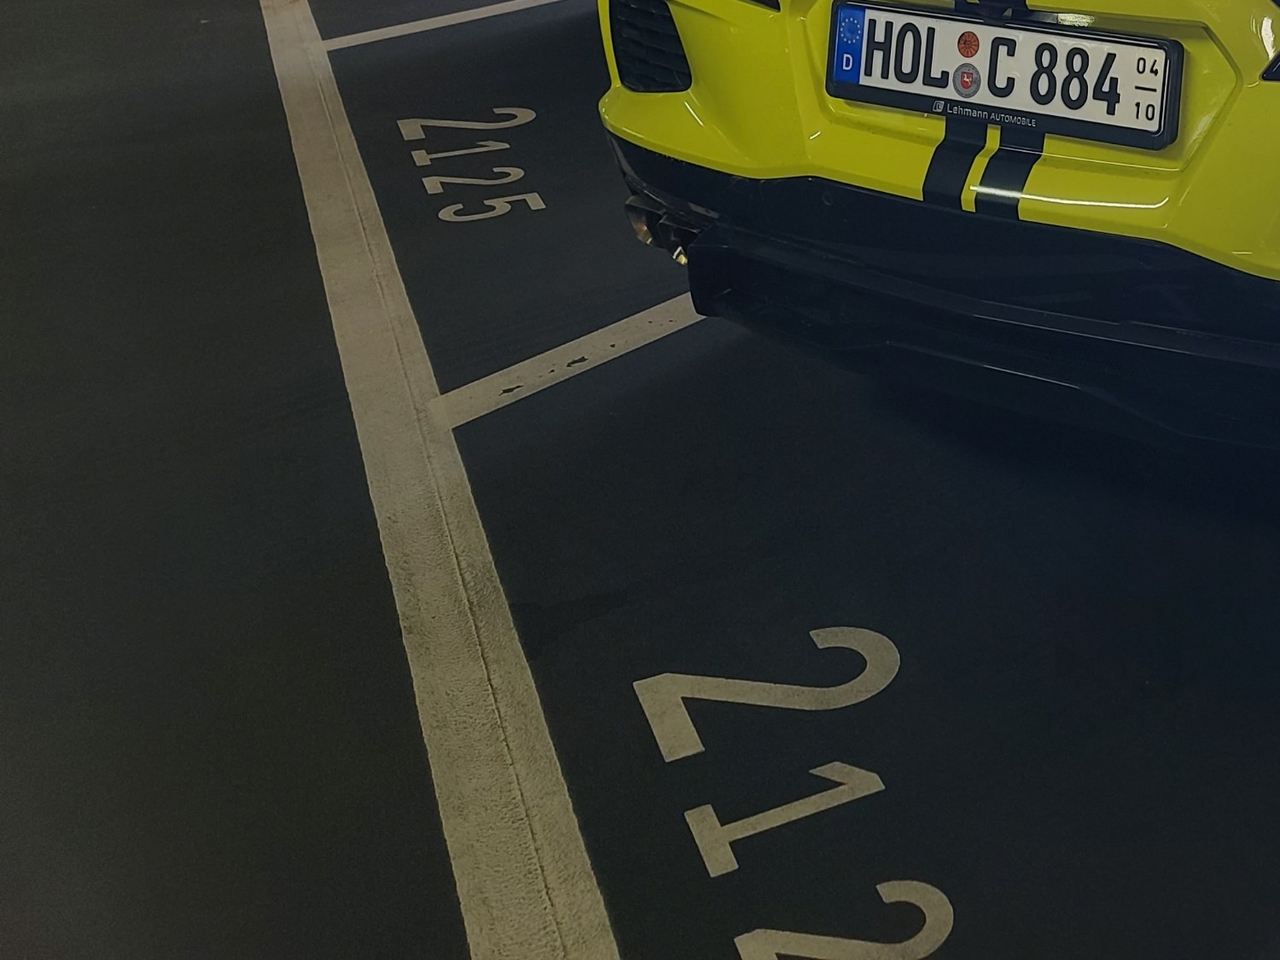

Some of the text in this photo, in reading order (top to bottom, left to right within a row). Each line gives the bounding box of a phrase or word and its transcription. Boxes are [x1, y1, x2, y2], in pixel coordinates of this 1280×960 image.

[842, 53, 853, 71] D
[864, 18, 950, 89] HOL
[988, 37, 1018, 98] C
[1030, 42, 1121, 116] 884
[1136, 56, 1160, 77] 04
[946, 103, 989, 120] Lehmann
[1134, 101, 1156, 122] 10
[397, 107, 547, 222] 2125
